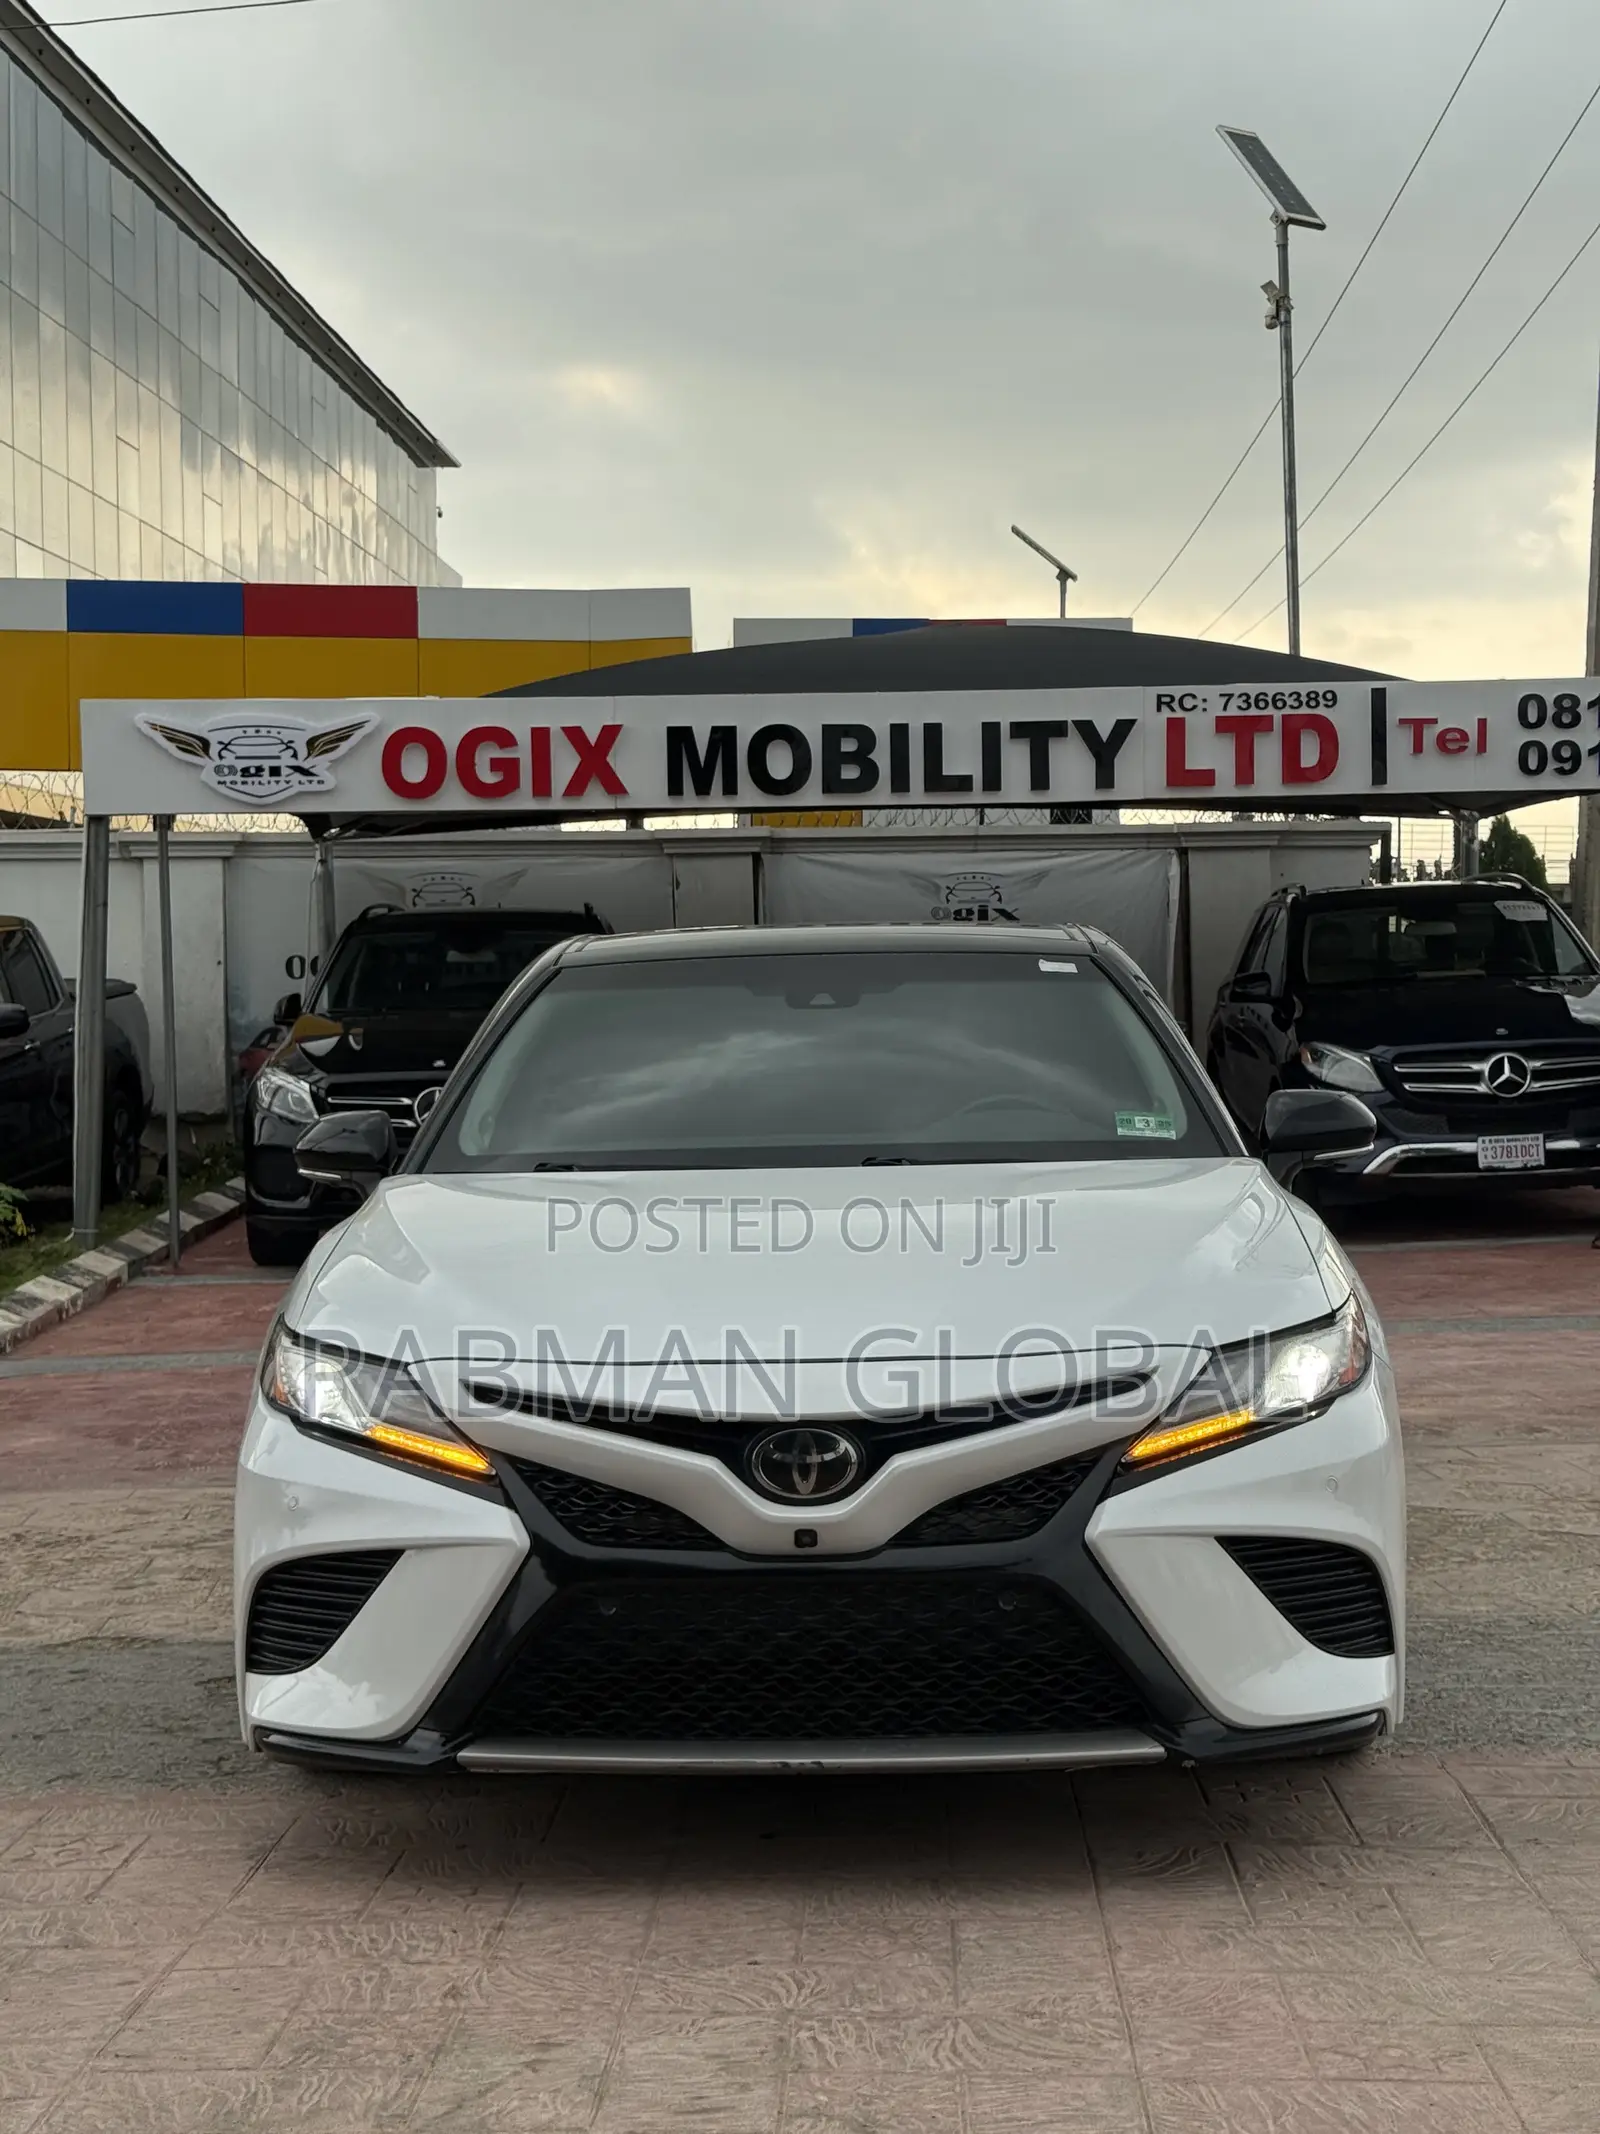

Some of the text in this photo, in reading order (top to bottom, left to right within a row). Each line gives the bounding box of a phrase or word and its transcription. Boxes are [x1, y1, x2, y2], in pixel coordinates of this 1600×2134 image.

[1156, 690, 1338, 713] RC: 7366389
[1398, 717, 1488, 755] Tel
[381, 713, 1340, 799] OGIX MOBILITY LTD
